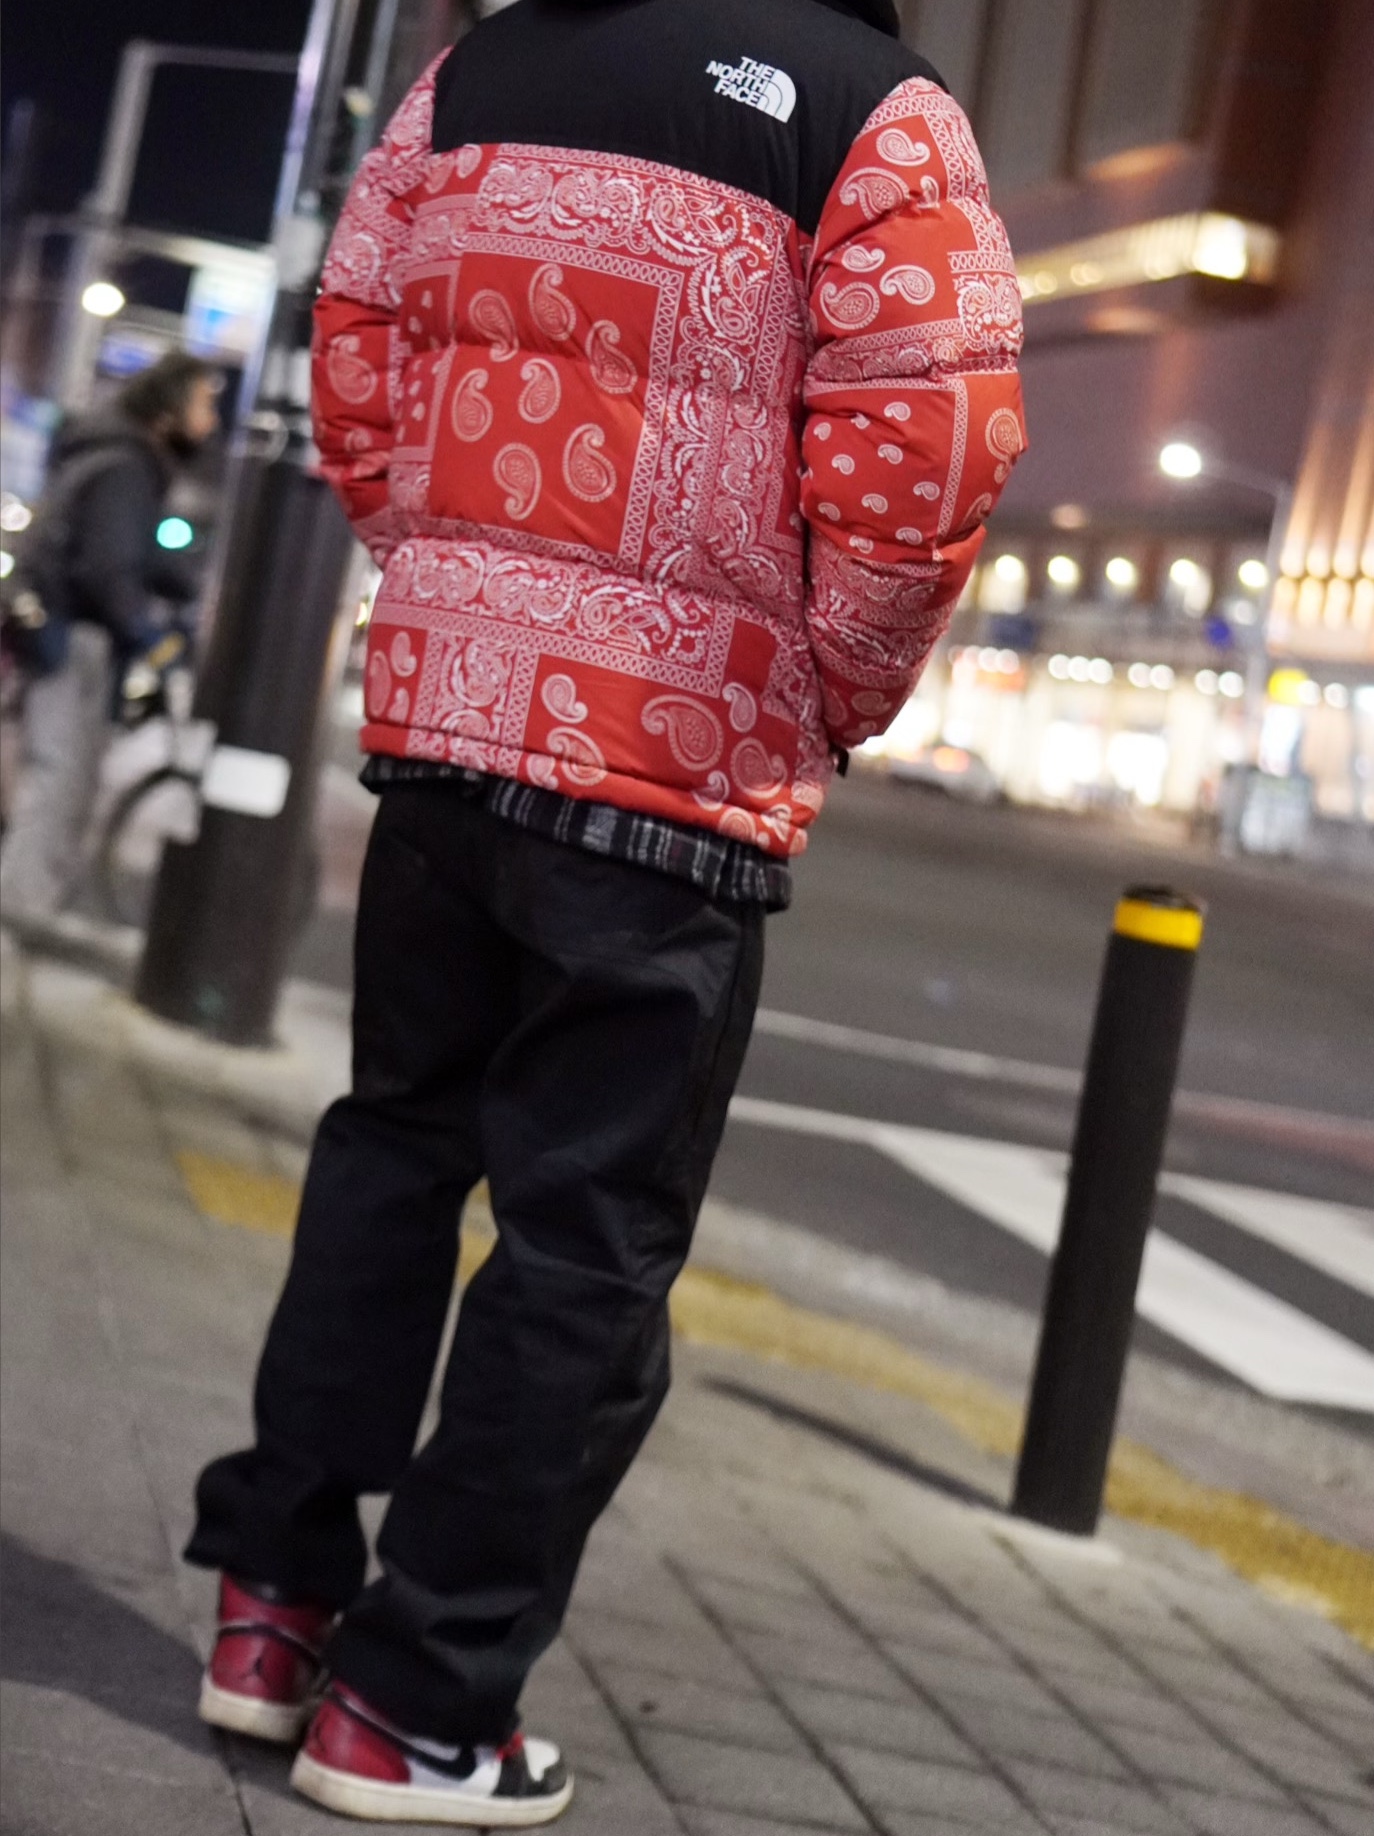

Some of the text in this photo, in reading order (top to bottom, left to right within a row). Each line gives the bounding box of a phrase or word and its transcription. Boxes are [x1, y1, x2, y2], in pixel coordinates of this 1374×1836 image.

[705, 60, 768, 93] NORTH
[739, 56, 776, 80] THE
[713, 78, 761, 107] FACE
